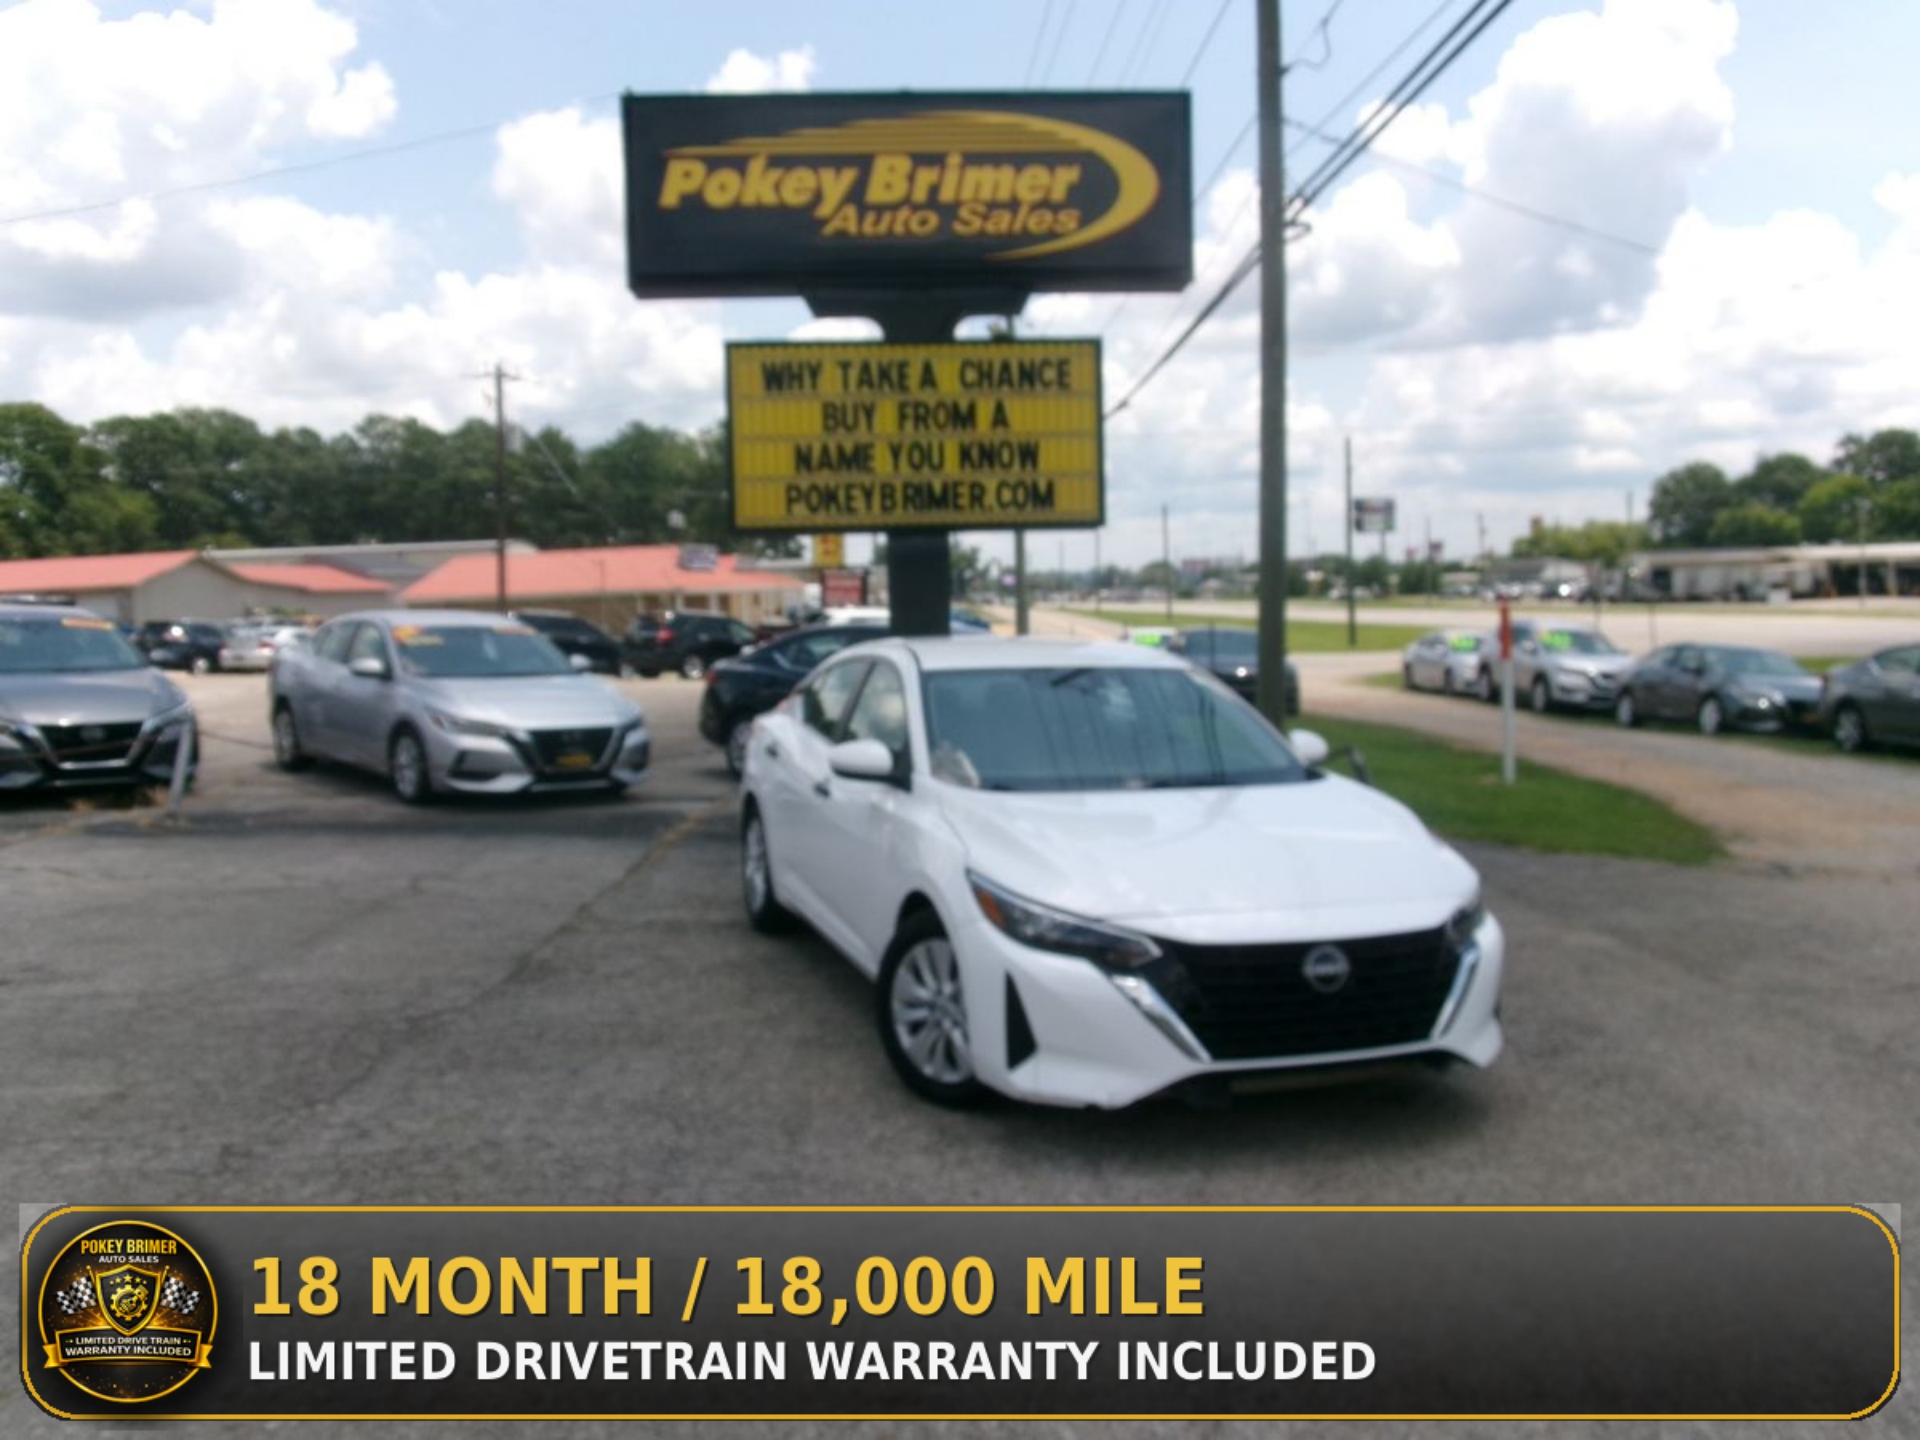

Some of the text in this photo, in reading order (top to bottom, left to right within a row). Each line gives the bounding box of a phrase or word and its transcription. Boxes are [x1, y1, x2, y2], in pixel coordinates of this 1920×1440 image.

[659, 152, 1082, 218] Pokey Brimer
[821, 203, 1081, 239] Auto Sales
[762, 357, 1073, 392] WHY TAKE A CHANCE
[822, 401, 1010, 433] BUY FROM A
[794, 441, 1040, 472] NAME YOU KNOW
[786, 479, 1055, 514] POKEYBRIMER.COM
